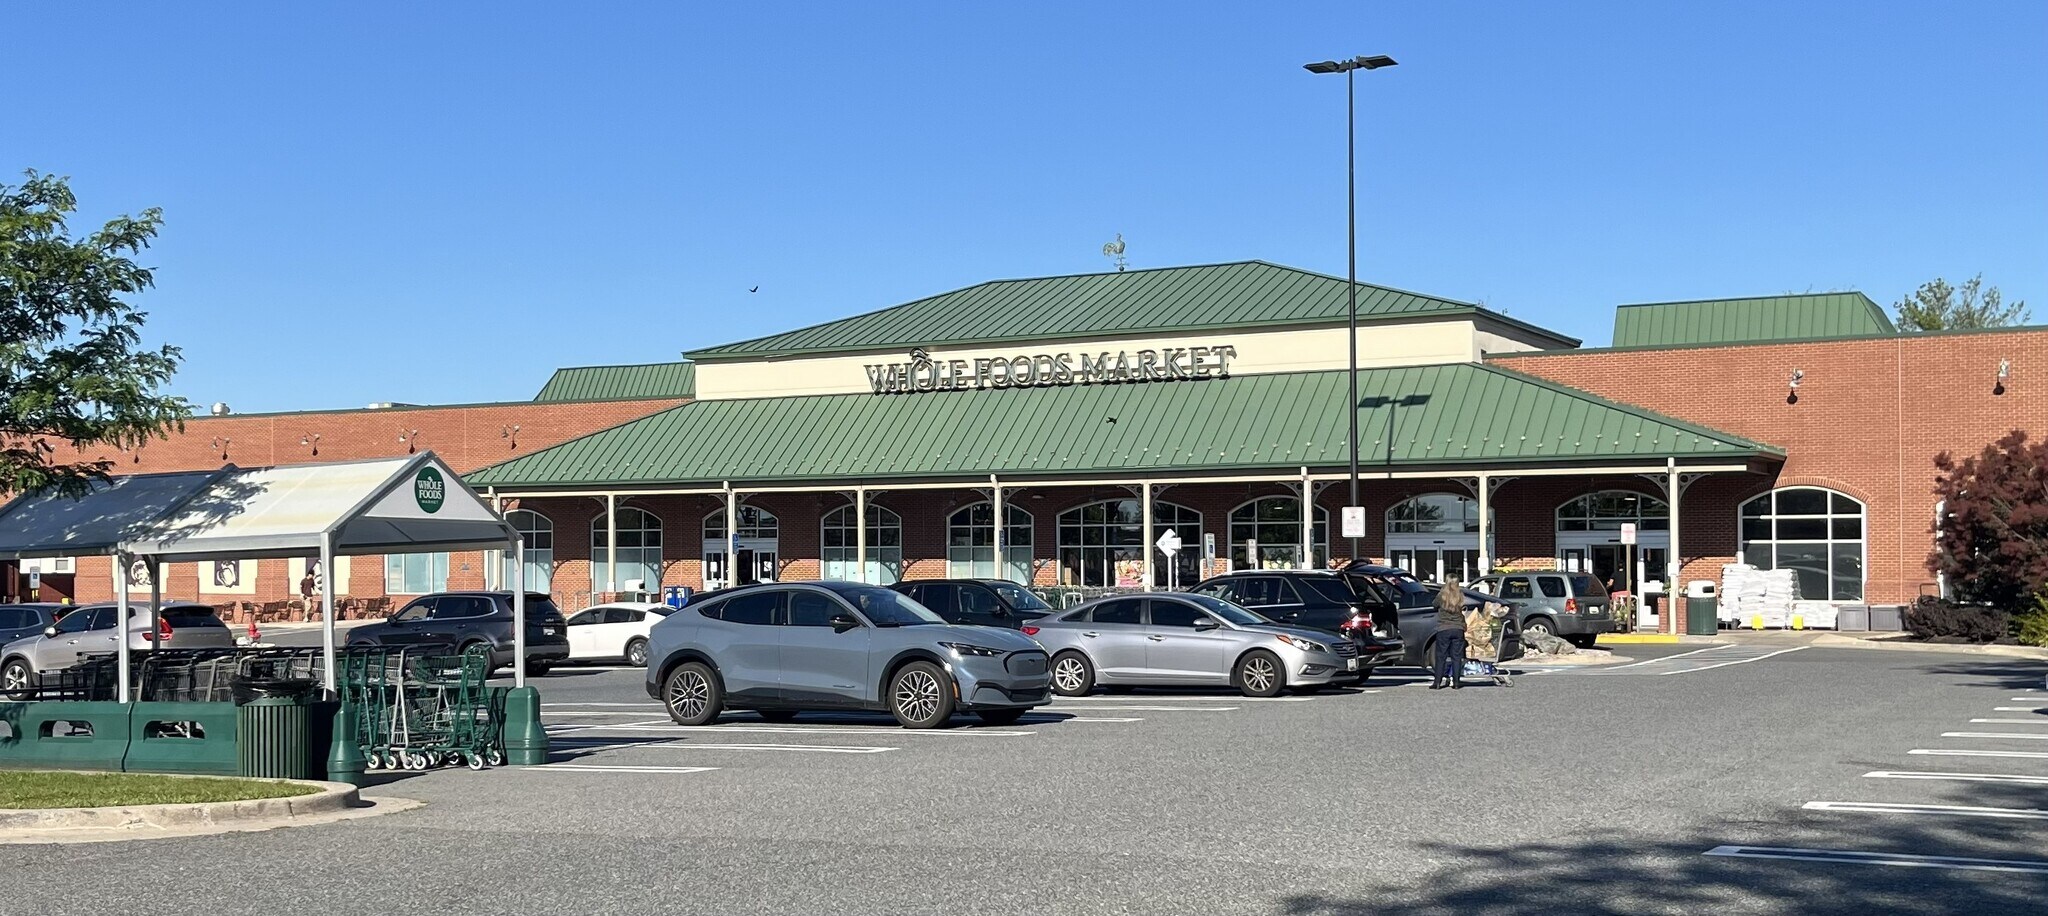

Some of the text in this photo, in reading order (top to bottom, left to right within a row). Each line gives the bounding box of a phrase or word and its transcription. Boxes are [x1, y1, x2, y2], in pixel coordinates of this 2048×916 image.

[863, 345, 1237, 394] WHOLE FOODS MARKET
[417, 479, 442, 490] WHOLE
[419, 489, 442, 499] FOODS
